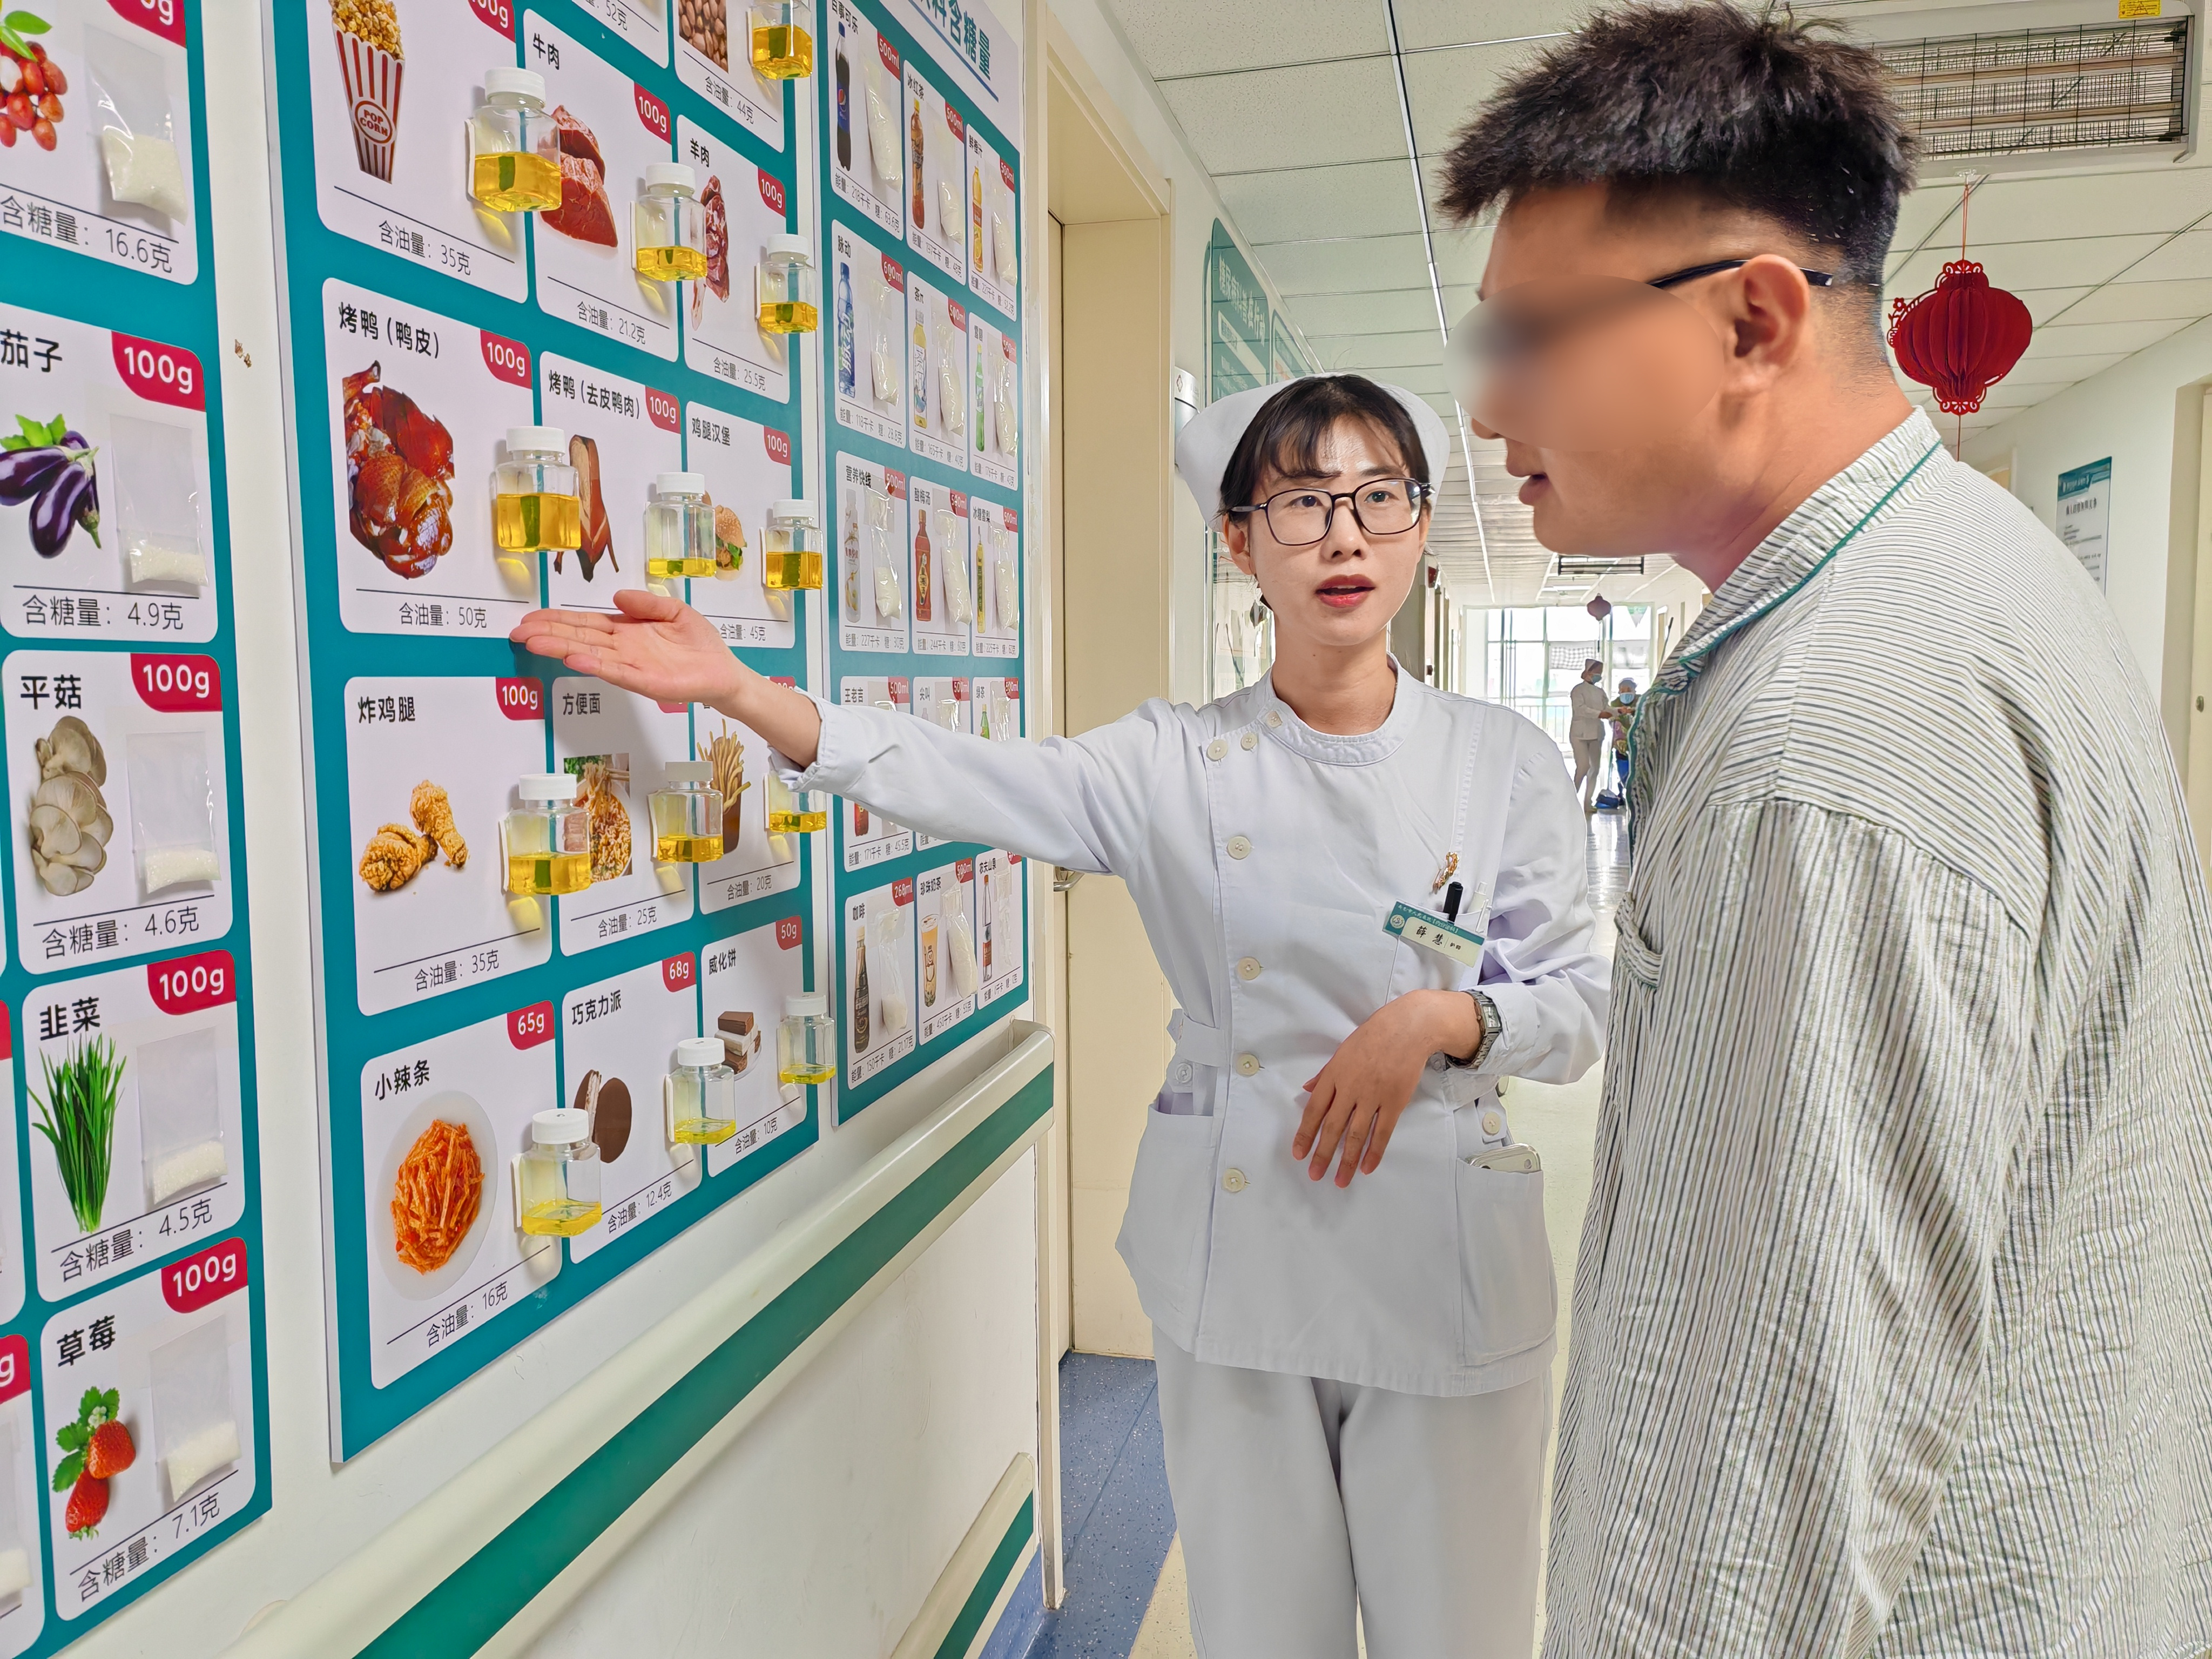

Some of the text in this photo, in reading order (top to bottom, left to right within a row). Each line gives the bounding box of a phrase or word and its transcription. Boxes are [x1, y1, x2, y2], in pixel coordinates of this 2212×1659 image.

[532, 33, 560, 70] 牛肉
[879, 38, 900, 70] 500ml
[926, 0, 991, 80] 料含糖量
[705, 76, 754, 124] 含油量：44克
[907, 71, 924, 99] 冰红茶
[363, 109, 384, 123] POP
[638, 94, 667, 126] 100g
[947, 109, 963, 132] 500ml
[360, 119, 388, 137] CORN
[690, 138, 710, 167] 羊肉
[760, 178, 783, 209] 100g
[1, 195, 172, 273] 含糖量：16.6克
[379, 220, 471, 276] 含油量：35克
[838, 235, 851, 258] 脉动
[884, 261, 903, 285] 600ml
[577, 301, 646, 345] 含油量：21.2克
[949, 304, 966, 325] 500ml
[338, 302, 440, 359] 烤鸭（鸭皮）
[0, 329, 63, 372] 茄子
[487, 342, 525, 377] 100g
[124, 346, 193, 395] 100g
[713, 357, 766, 391] 含油量：25.5克
[549, 370, 640, 420] 烤鸭（去皮鸭肉）
[650, 397, 676, 424] 100g
[692, 417, 731, 446] 鸡腿汉堡
[767, 432, 788, 457] 100g
[846, 465, 871, 488] 营养快线
[886, 474, 906, 491] 500ml
[951, 494, 967, 509] 500ml
[22, 595, 184, 630] 含糖量：4.9克
[399, 602, 487, 629] 含油量：50克
[20, 674, 82, 710] 平菇
[143, 664, 210, 698] 100g
[891, 681, 909, 694] 500ml
[920, 686, 930, 701] 尖叫
[954, 681, 969, 693] 500ml
[358, 696, 415, 723] 炸鸡腿
[502, 685, 538, 710] 100g
[562, 693, 601, 715] 方便面
[957, 861, 972, 876] 500ml
[727, 874, 772, 901] 含油量：20克
[894, 880, 913, 899] 268ml
[920, 876, 941, 896] 珍珠奶茶
[598, 906, 657, 939] 含油量：25克
[853, 903, 865, 921] 咖啡
[42, 906, 199, 960] 含糖量：4.6克
[781, 923, 797, 940] 50g
[414, 949, 499, 992] 含油量：35克
[670, 961, 690, 980] 68g
[709, 948, 737, 975] 威化饼
[159, 966, 225, 1001] 100g
[39, 996, 100, 1041] 韭菜
[518, 1011, 544, 1035] 65g
[572, 989, 622, 1026] 巧克力派
[374, 1060, 430, 1101] 小辣条
[735, 1116, 778, 1155] 含油量：10克
[608, 1181, 672, 1235] 含油量：12.4克
[60, 1198, 213, 1283] 含糖量：4.5克
[172, 1253, 237, 1297] 100g
[427, 1280, 509, 1348] 含油量：16克
[57, 1314, 116, 1367] 草莓
[78, 1492, 220, 1602] 含糖量：7.1克
